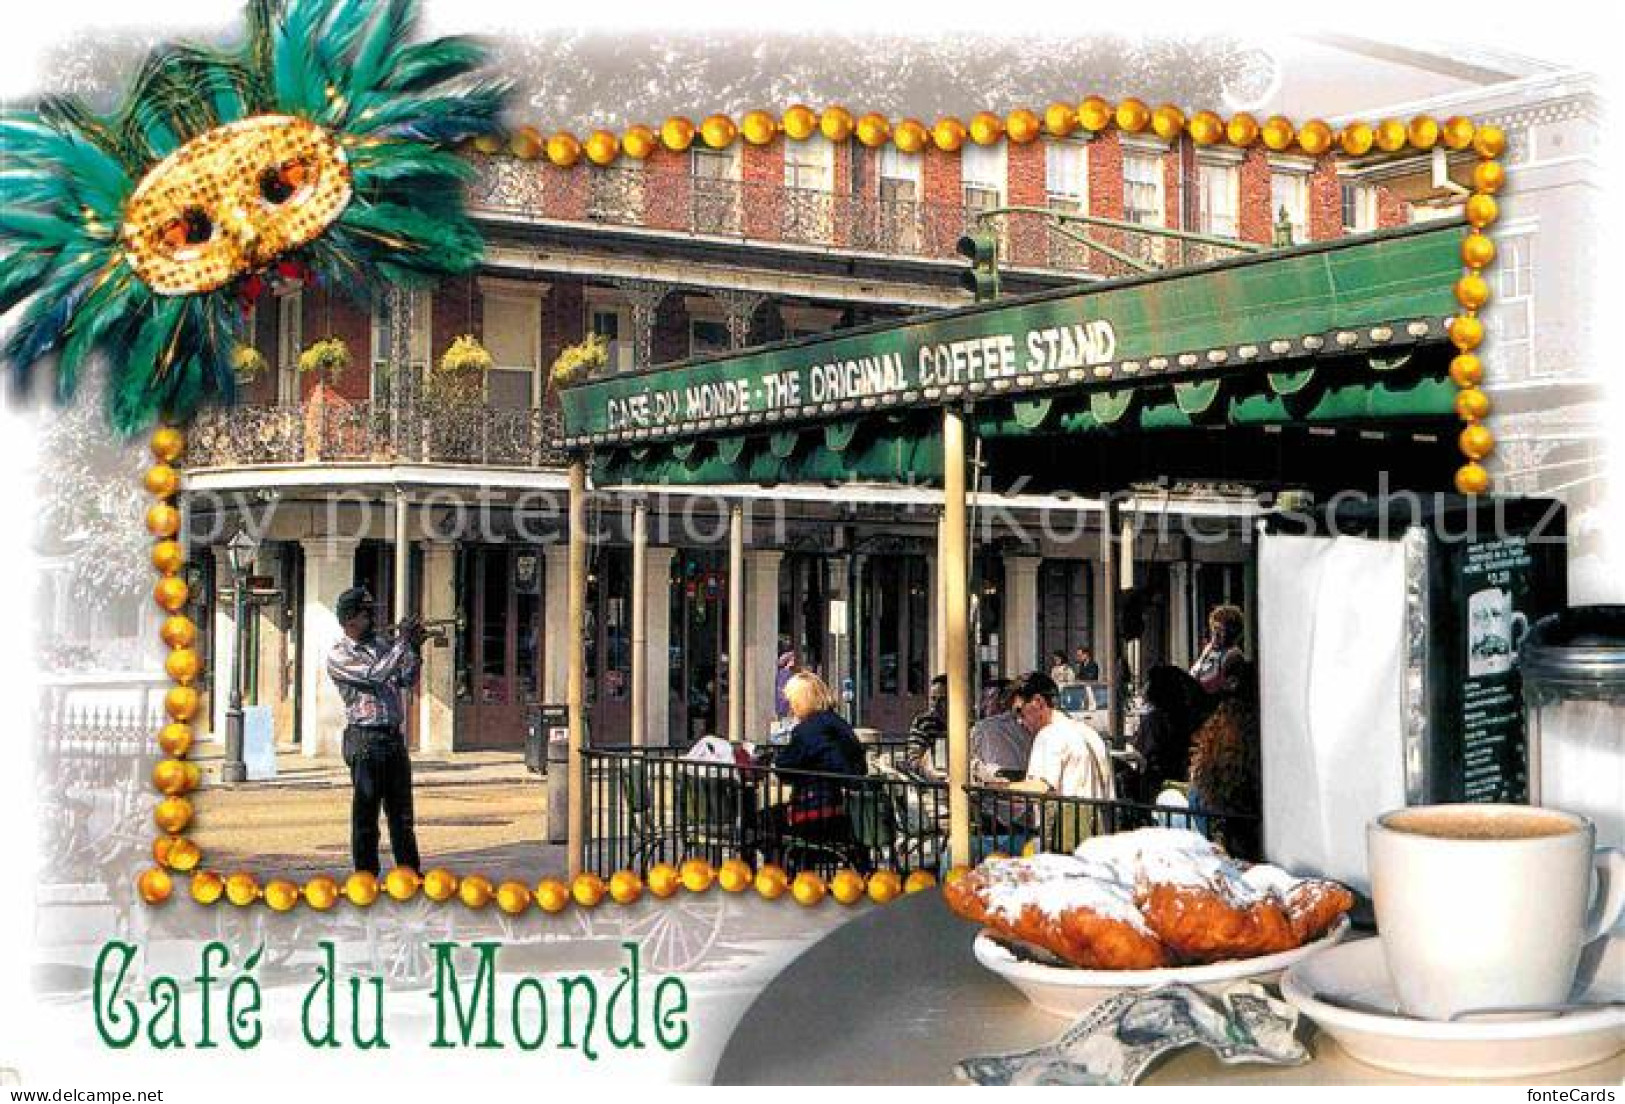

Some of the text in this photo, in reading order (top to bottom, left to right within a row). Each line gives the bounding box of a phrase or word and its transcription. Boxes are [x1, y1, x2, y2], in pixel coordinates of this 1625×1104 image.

[655, 390, 679, 425] DU
[686, 378, 748, 420] MONDE
[762, 372, 801, 409] THE
[811, 352, 908, 401] ORIGINAL
[918, 334, 1017, 386] COFFEE
[1026, 319, 1116, 372] STAND
[92, 940, 689, 1061] Café du Monde
